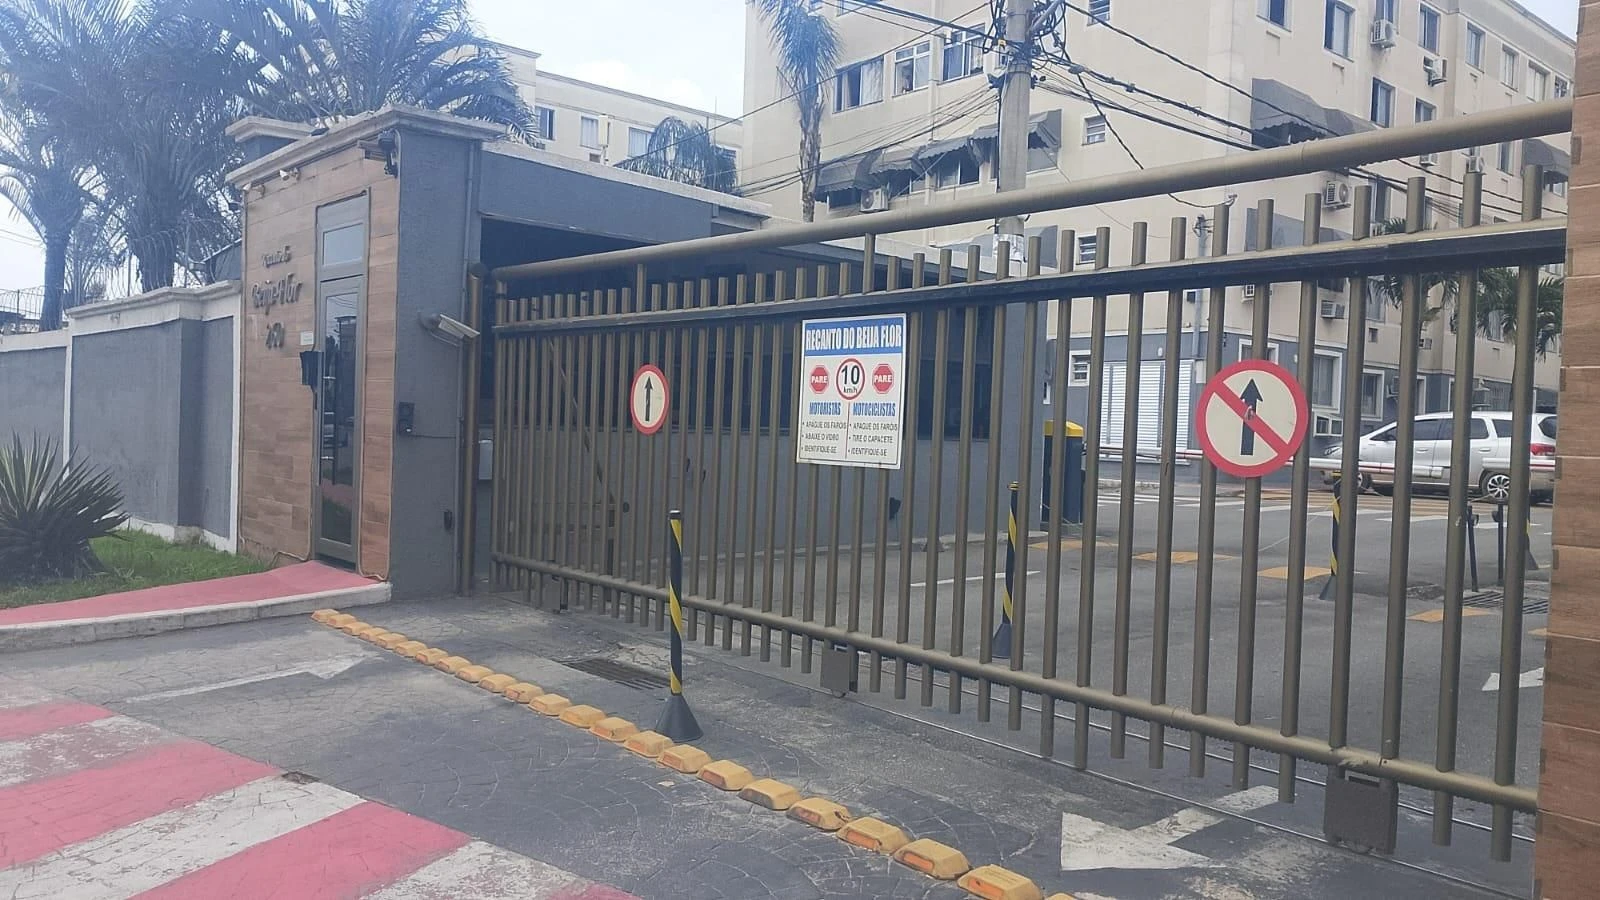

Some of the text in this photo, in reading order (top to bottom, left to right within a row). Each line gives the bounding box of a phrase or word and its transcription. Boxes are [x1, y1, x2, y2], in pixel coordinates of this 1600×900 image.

[806, 324, 902, 351] RECANTO DO BEIJA FLOR
[841, 365, 860, 385] 10
[874, 374, 892, 382] PARE
[843, 386, 858, 394] km/h
[809, 402, 841, 415] MOTORISTAS
[853, 402, 896, 416] MOTOCICLISTAS
[852, 434, 863, 442] TIRE
[868, 435, 893, 443] CAPACETE
[850, 448, 887, 456] IDENTIFIQUE-SE
